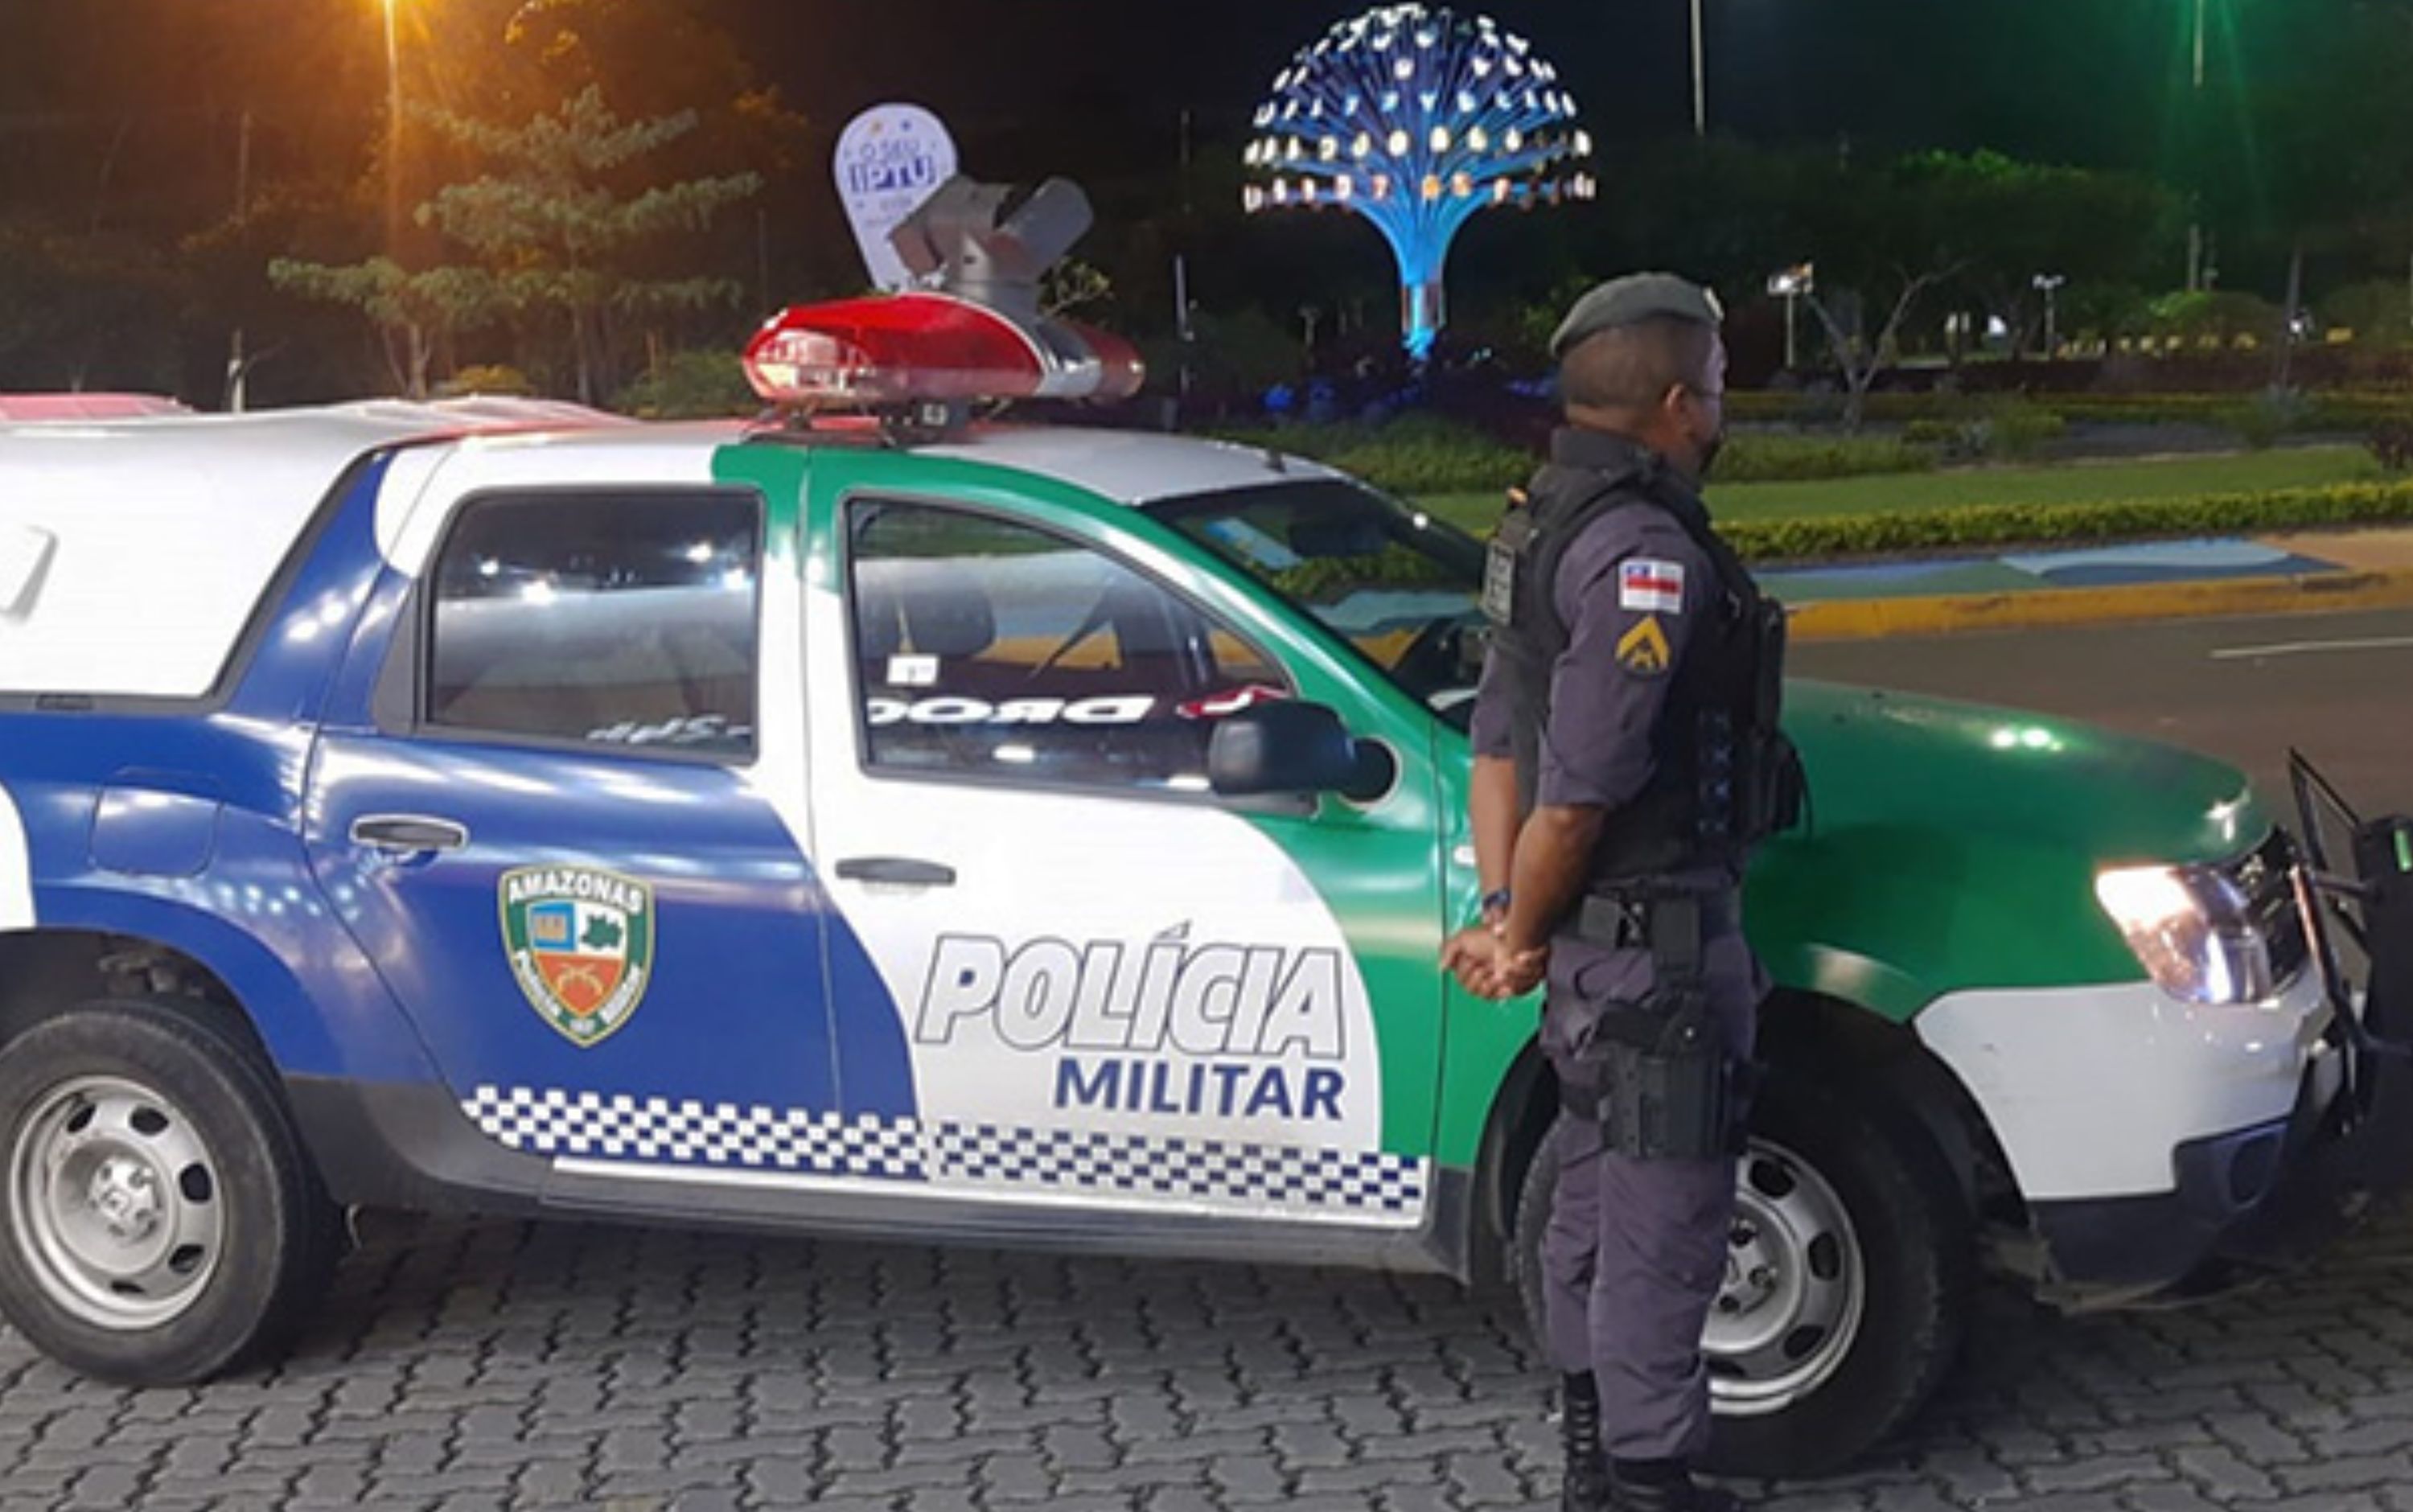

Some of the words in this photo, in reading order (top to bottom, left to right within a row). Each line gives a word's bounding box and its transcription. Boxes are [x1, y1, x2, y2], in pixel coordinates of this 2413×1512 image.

[849, 156, 935, 193] IPTU
[508, 870, 643, 914] AMAZONAS
[915, 919, 1346, 1060] POLÍCIA
[1054, 1058, 1346, 1120] MILITAR
